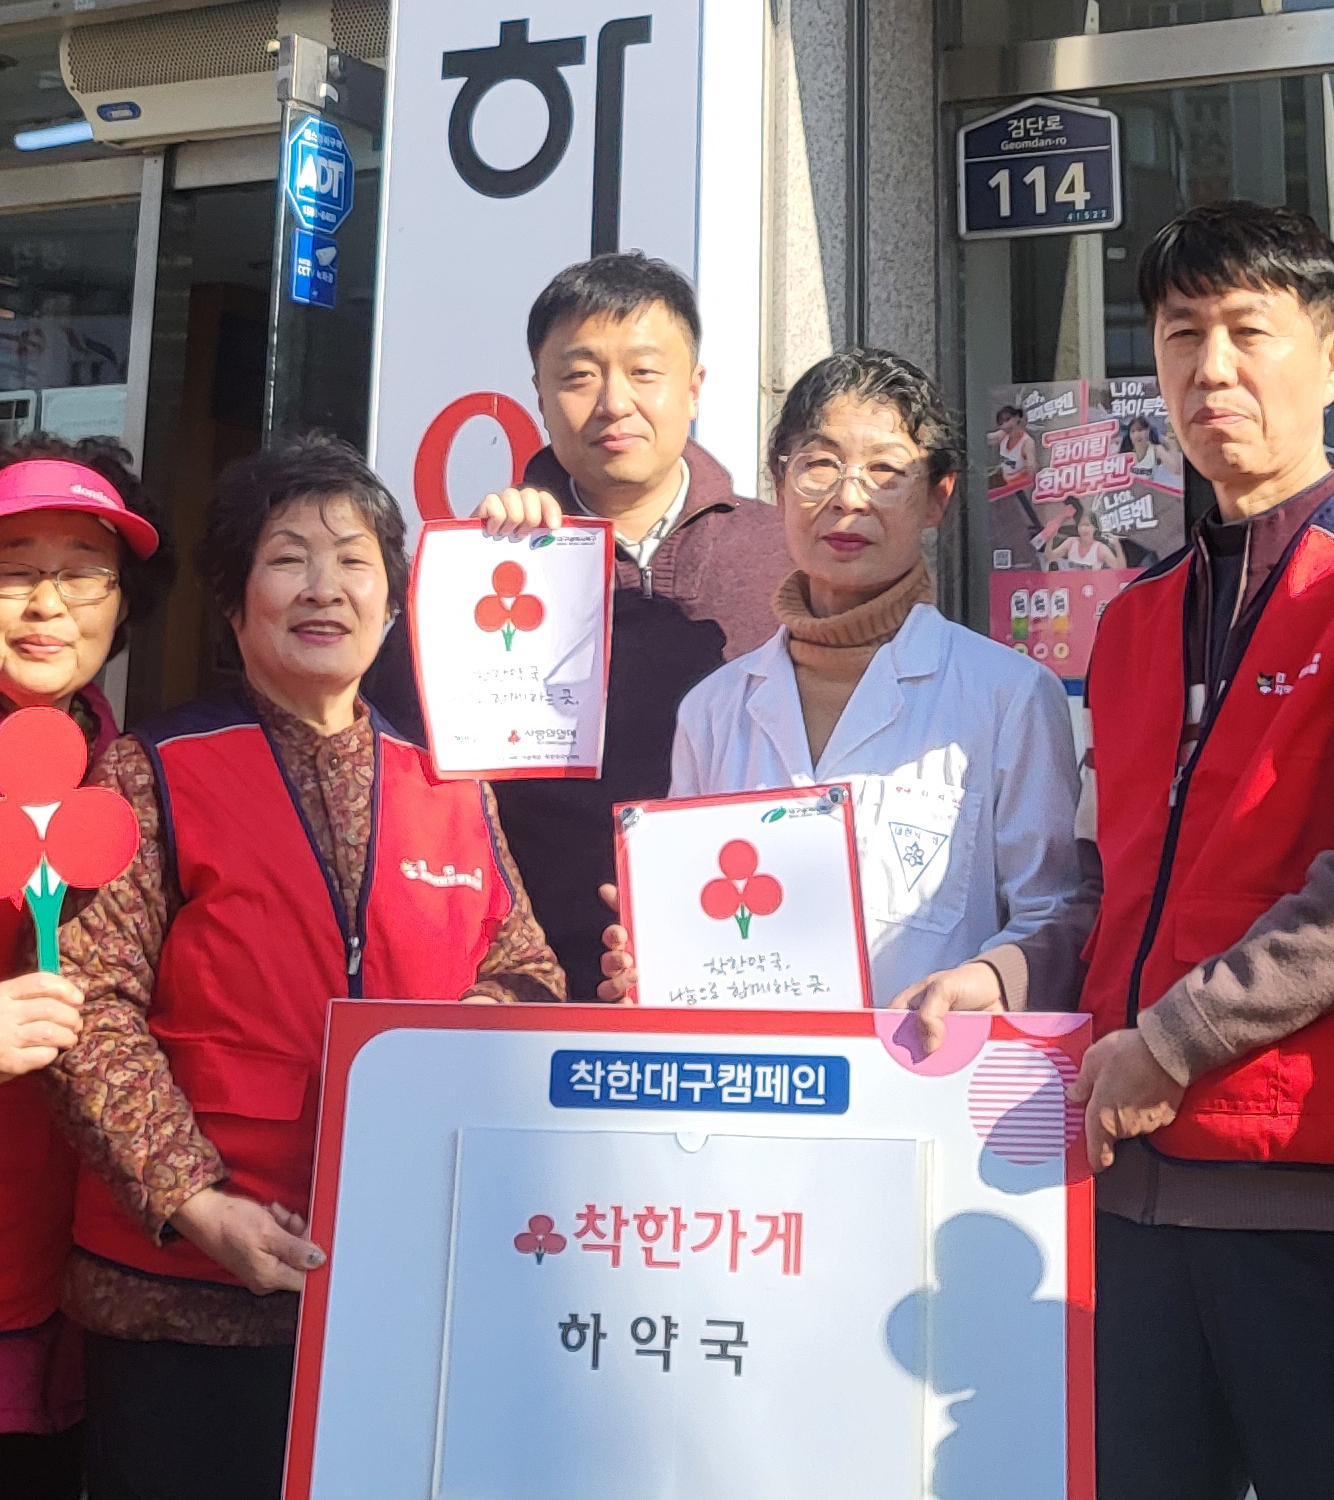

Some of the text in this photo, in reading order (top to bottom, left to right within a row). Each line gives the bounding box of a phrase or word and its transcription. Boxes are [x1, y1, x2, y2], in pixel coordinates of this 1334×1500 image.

[1000, 136, 1067, 150] Geomdan-ro
[1007, 114, 1064, 138] 검단로
[297, 153, 345, 199] ADT
[988, 161, 1091, 218] 114
[569, 1059, 826, 1106] 착한대구캠페인
[574, 1202, 805, 1277] 착한가게
